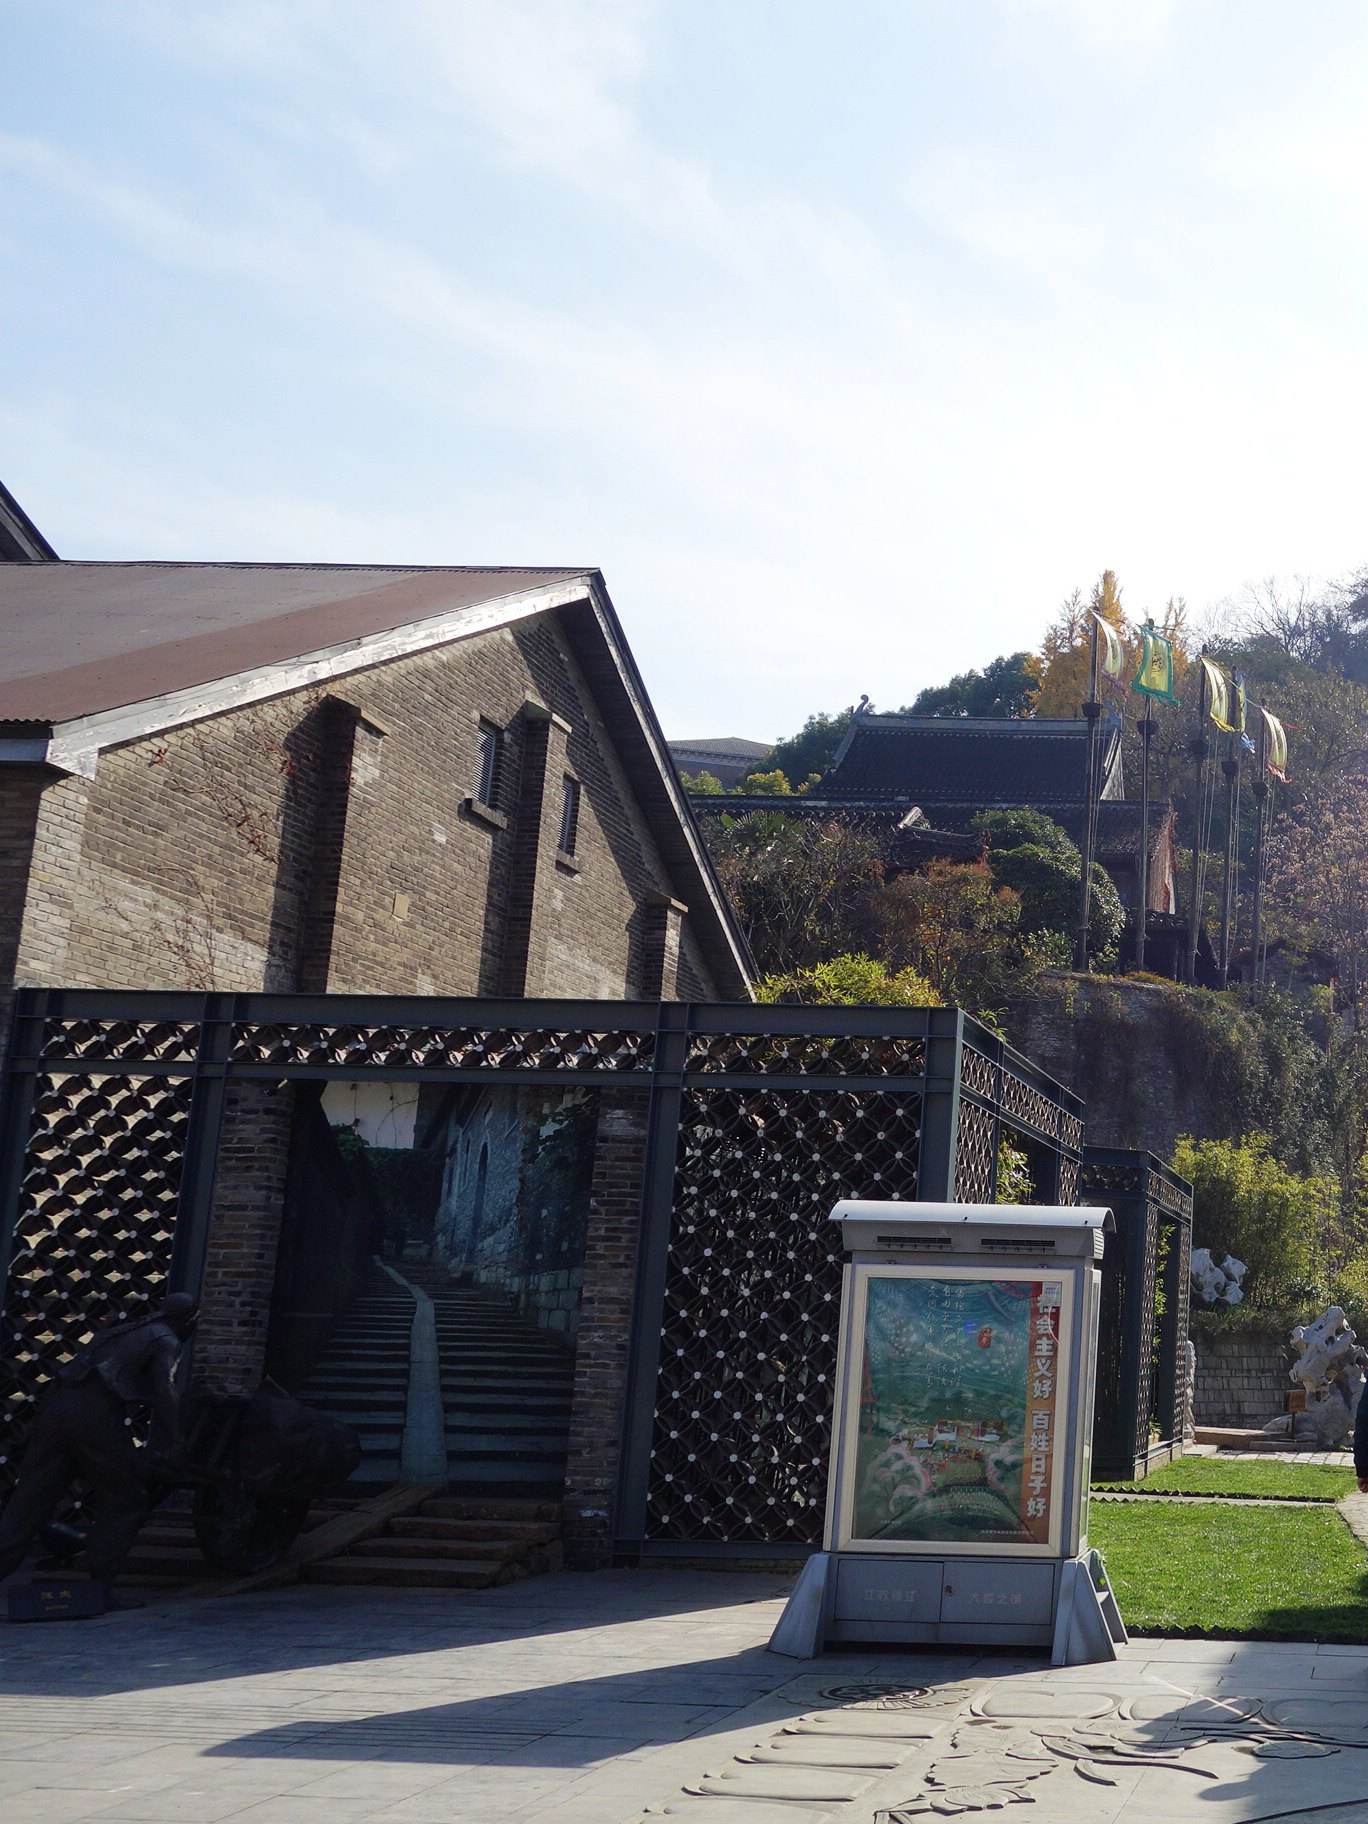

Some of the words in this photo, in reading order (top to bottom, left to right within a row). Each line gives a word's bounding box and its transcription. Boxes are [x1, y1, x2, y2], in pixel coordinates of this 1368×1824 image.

[1027, 1410, 1051, 1518] 百姓日子好
